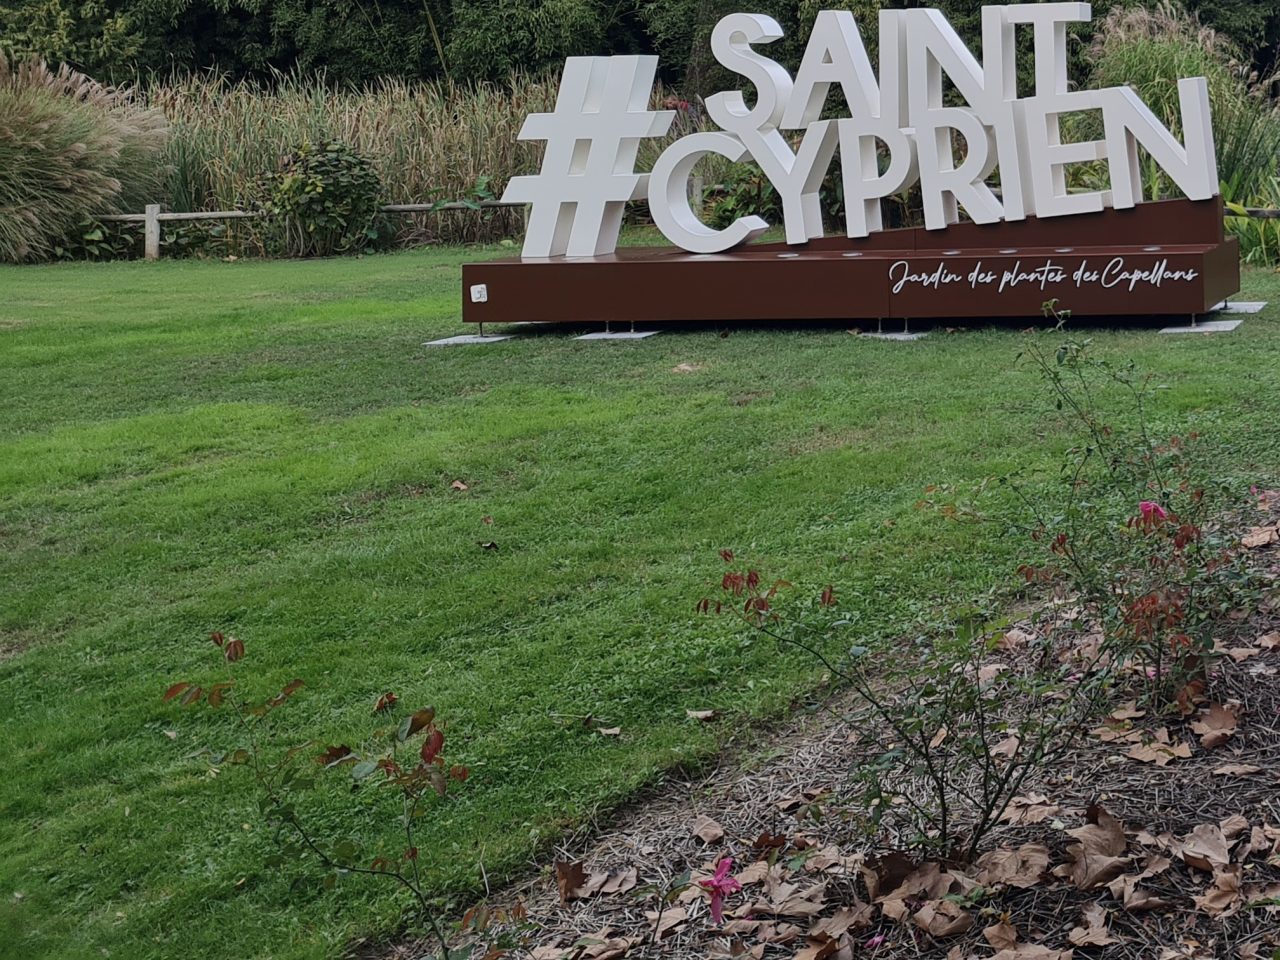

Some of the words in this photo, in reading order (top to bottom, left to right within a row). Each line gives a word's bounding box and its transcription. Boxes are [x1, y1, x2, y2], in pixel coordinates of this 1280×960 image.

[705, 1, 1092, 131] SAINT
[647, 76, 1220, 254] CYPRIEN
[888, 259, 962, 294] Jardin
[967, 260, 997, 289] des
[998, 258, 1067, 293] plantes
[1072, 259, 1100, 289] des
[1100, 257, 1199, 292] Capellans
